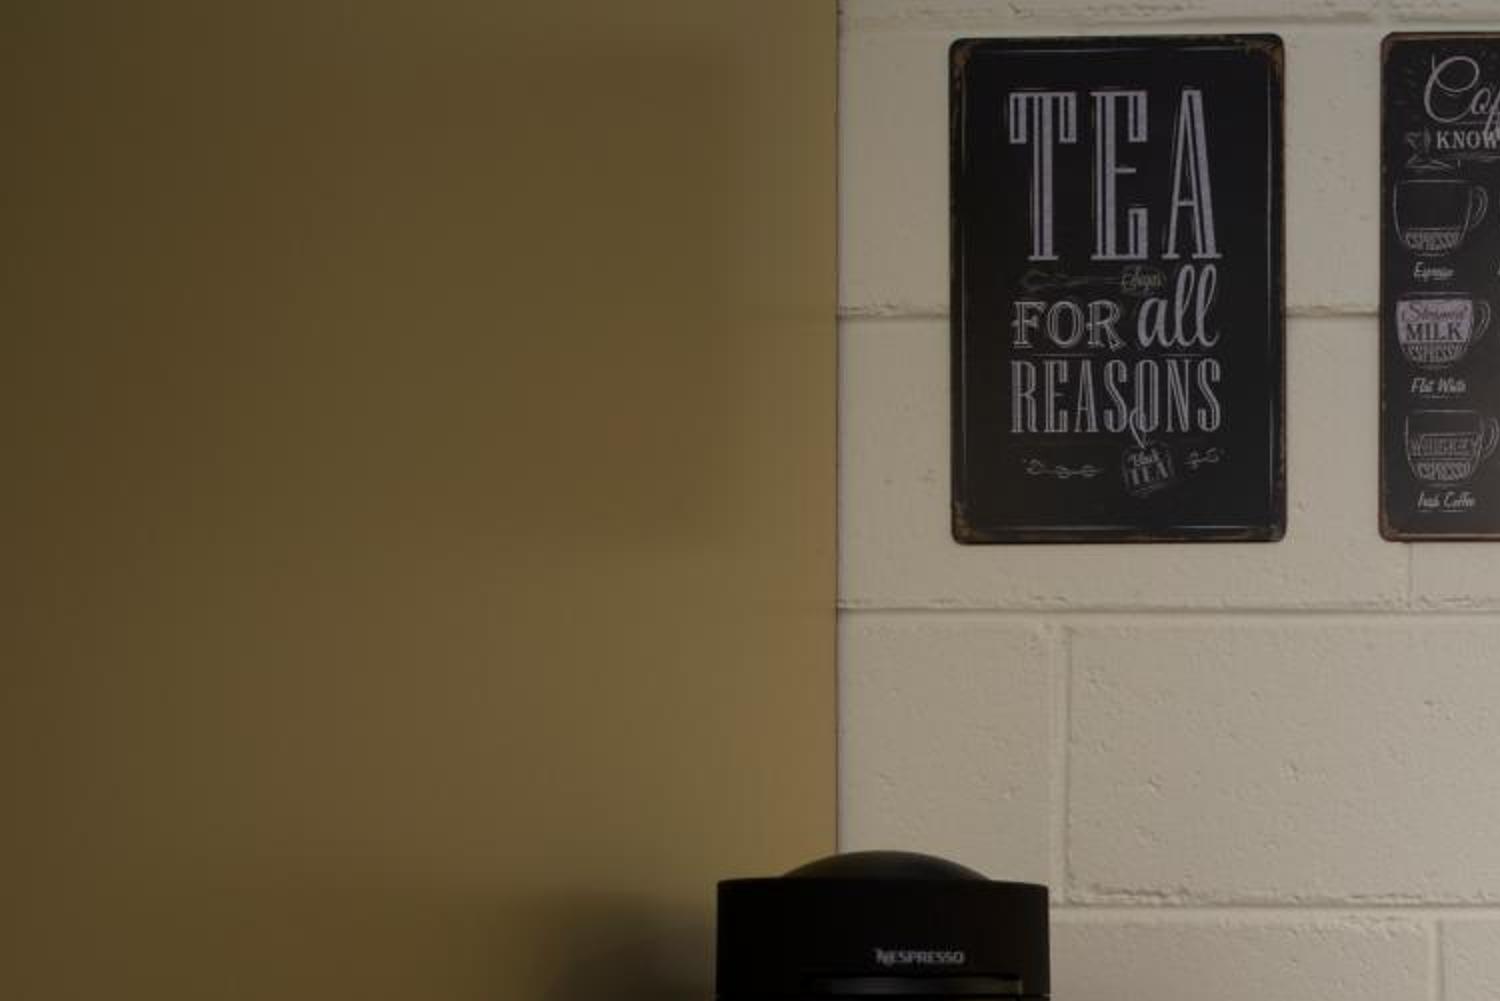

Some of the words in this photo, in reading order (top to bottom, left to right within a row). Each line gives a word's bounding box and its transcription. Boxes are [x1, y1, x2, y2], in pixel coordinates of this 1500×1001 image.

[1437, 129, 1497, 149] KNOW
[1008, 88, 1223, 260] TEA
[1010, 300, 1127, 350] FOR
[1136, 264, 1221, 347] all
[1407, 322, 1463, 341] MILK
[1010, 358, 1222, 433] REASONS
[874, 947, 966, 967] NESPRESSO
